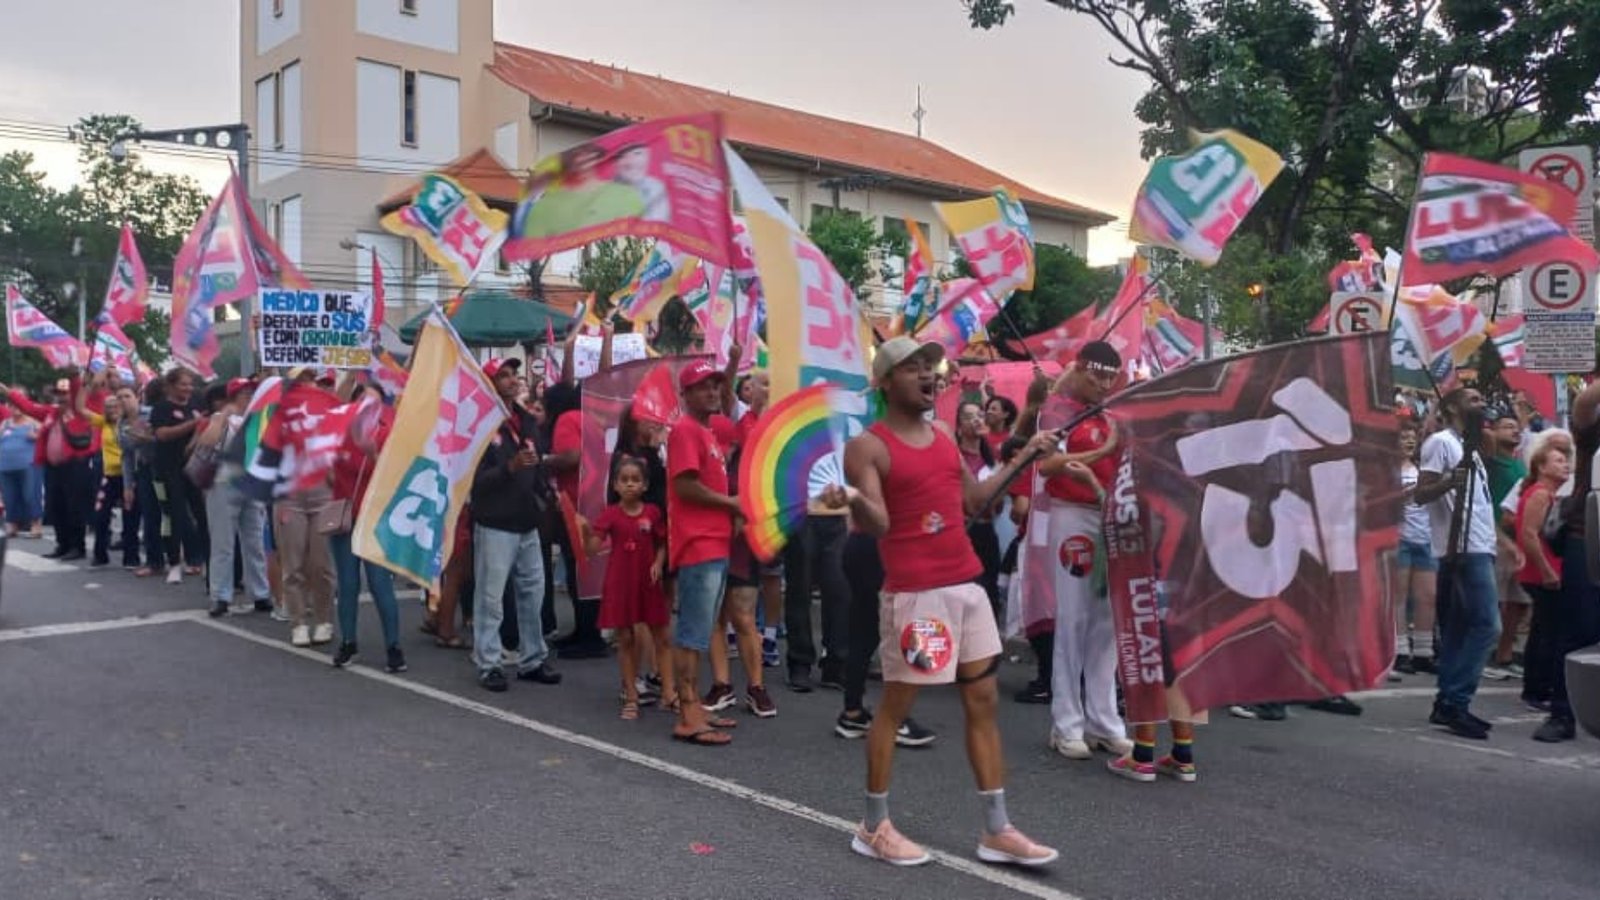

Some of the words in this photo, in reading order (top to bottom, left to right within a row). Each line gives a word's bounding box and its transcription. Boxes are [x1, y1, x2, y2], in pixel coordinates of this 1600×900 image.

[1549, 269, 1569, 298] E
[325, 294, 352, 312] QUE
[263, 314, 318, 329] DEFENDE
[321, 315, 330, 328] O
[332, 311, 366, 332] SUS
[1351, 307, 1372, 332] E
[263, 331, 271, 345] E
[264, 347, 319, 362] DEFENDE
[1176, 376, 1356, 600] 13
[1128, 577, 1164, 684] LULA13
